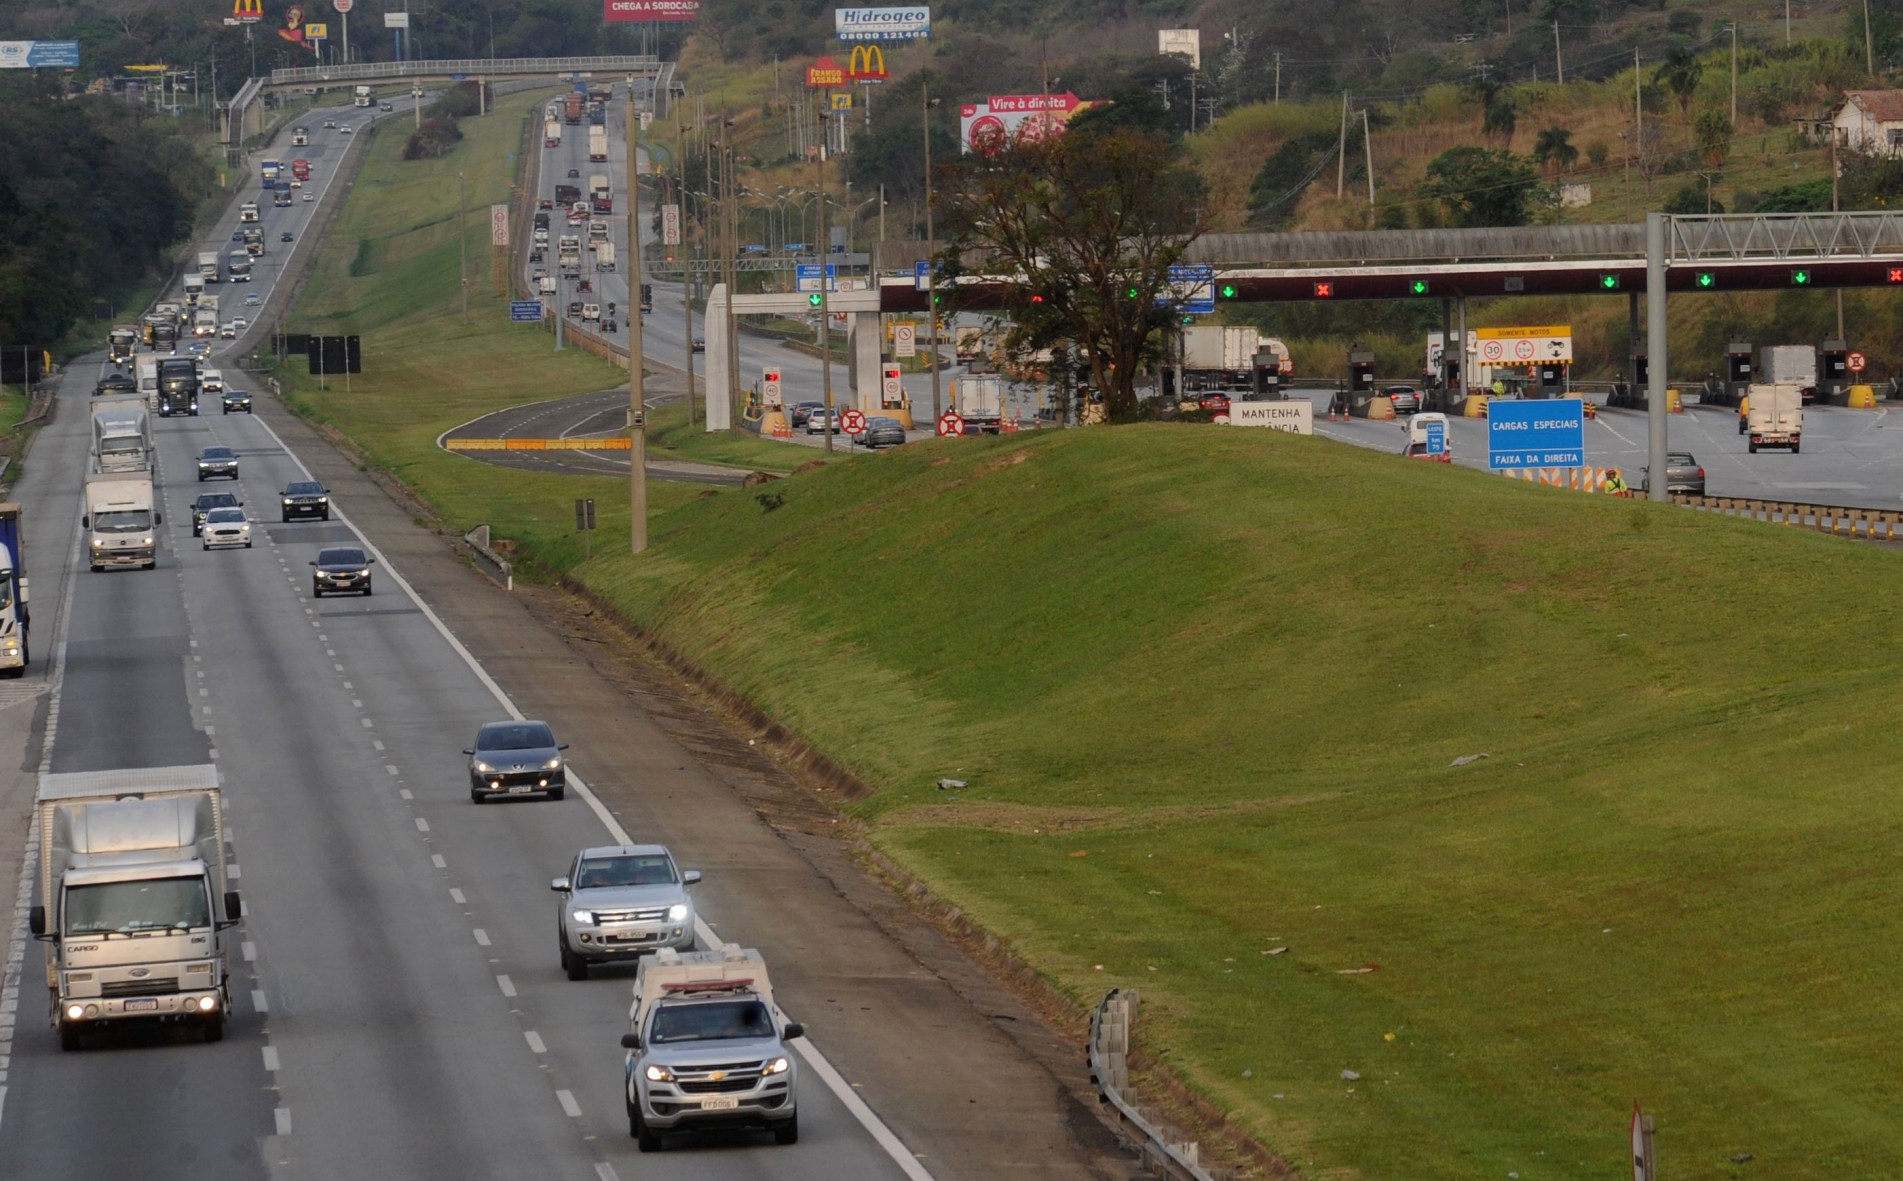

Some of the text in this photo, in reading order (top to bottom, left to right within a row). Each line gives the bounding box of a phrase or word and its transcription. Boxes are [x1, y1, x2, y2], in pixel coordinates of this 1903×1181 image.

[612, 2, 700, 10] CHEGA A SOROCABA
[844, 10, 926, 24] Hidrogeo
[840, 32, 880, 40] 08000
[811, 67, 842, 77] FRANGO
[811, 76, 842, 84] ASSADO
[992, 98, 1015, 110] Vire
[1018, 98, 1026, 109] à
[1487, 346, 1500, 355] 30
[1242, 408, 1301, 419] MANTENHA
[1492, 419, 1579, 431] CARGAS ESPECIAIS
[1495, 453, 1578, 464] FAIXA DA DIREITA
[67, 945, 99, 953] CARGO
